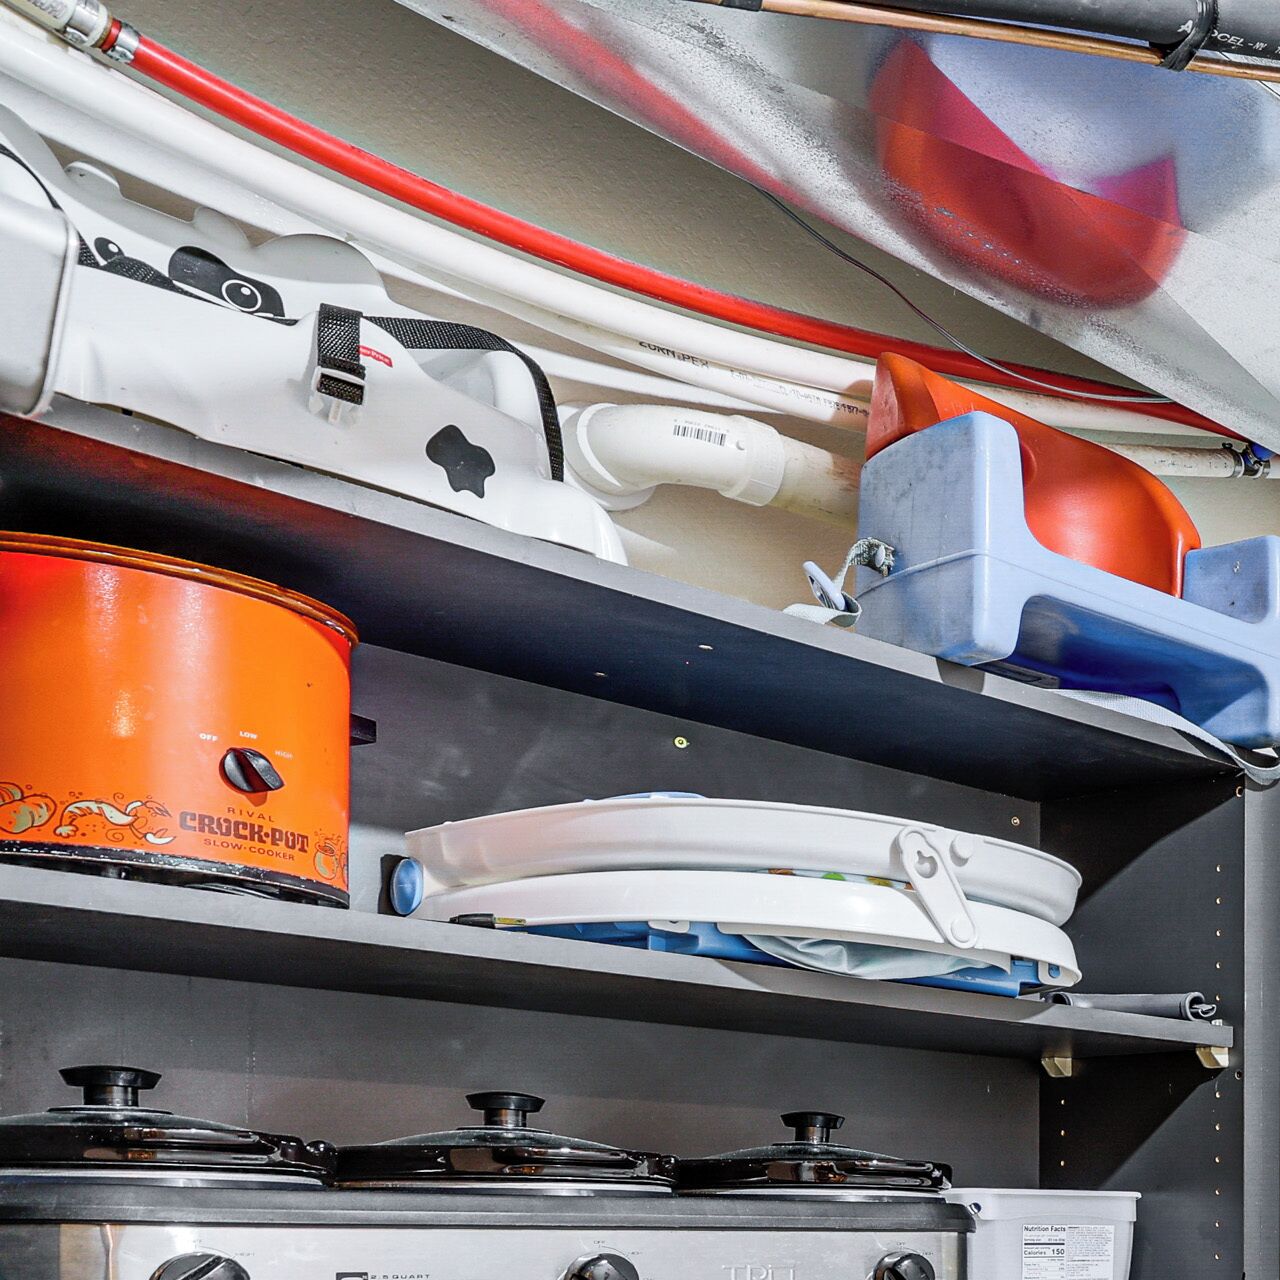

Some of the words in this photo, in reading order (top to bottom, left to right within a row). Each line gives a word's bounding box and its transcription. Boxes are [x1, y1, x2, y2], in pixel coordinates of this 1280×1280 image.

[199, 733, 218, 742] OFF
[239, 730, 258, 740] LOW
[227, 806, 276, 823] RIVAL
